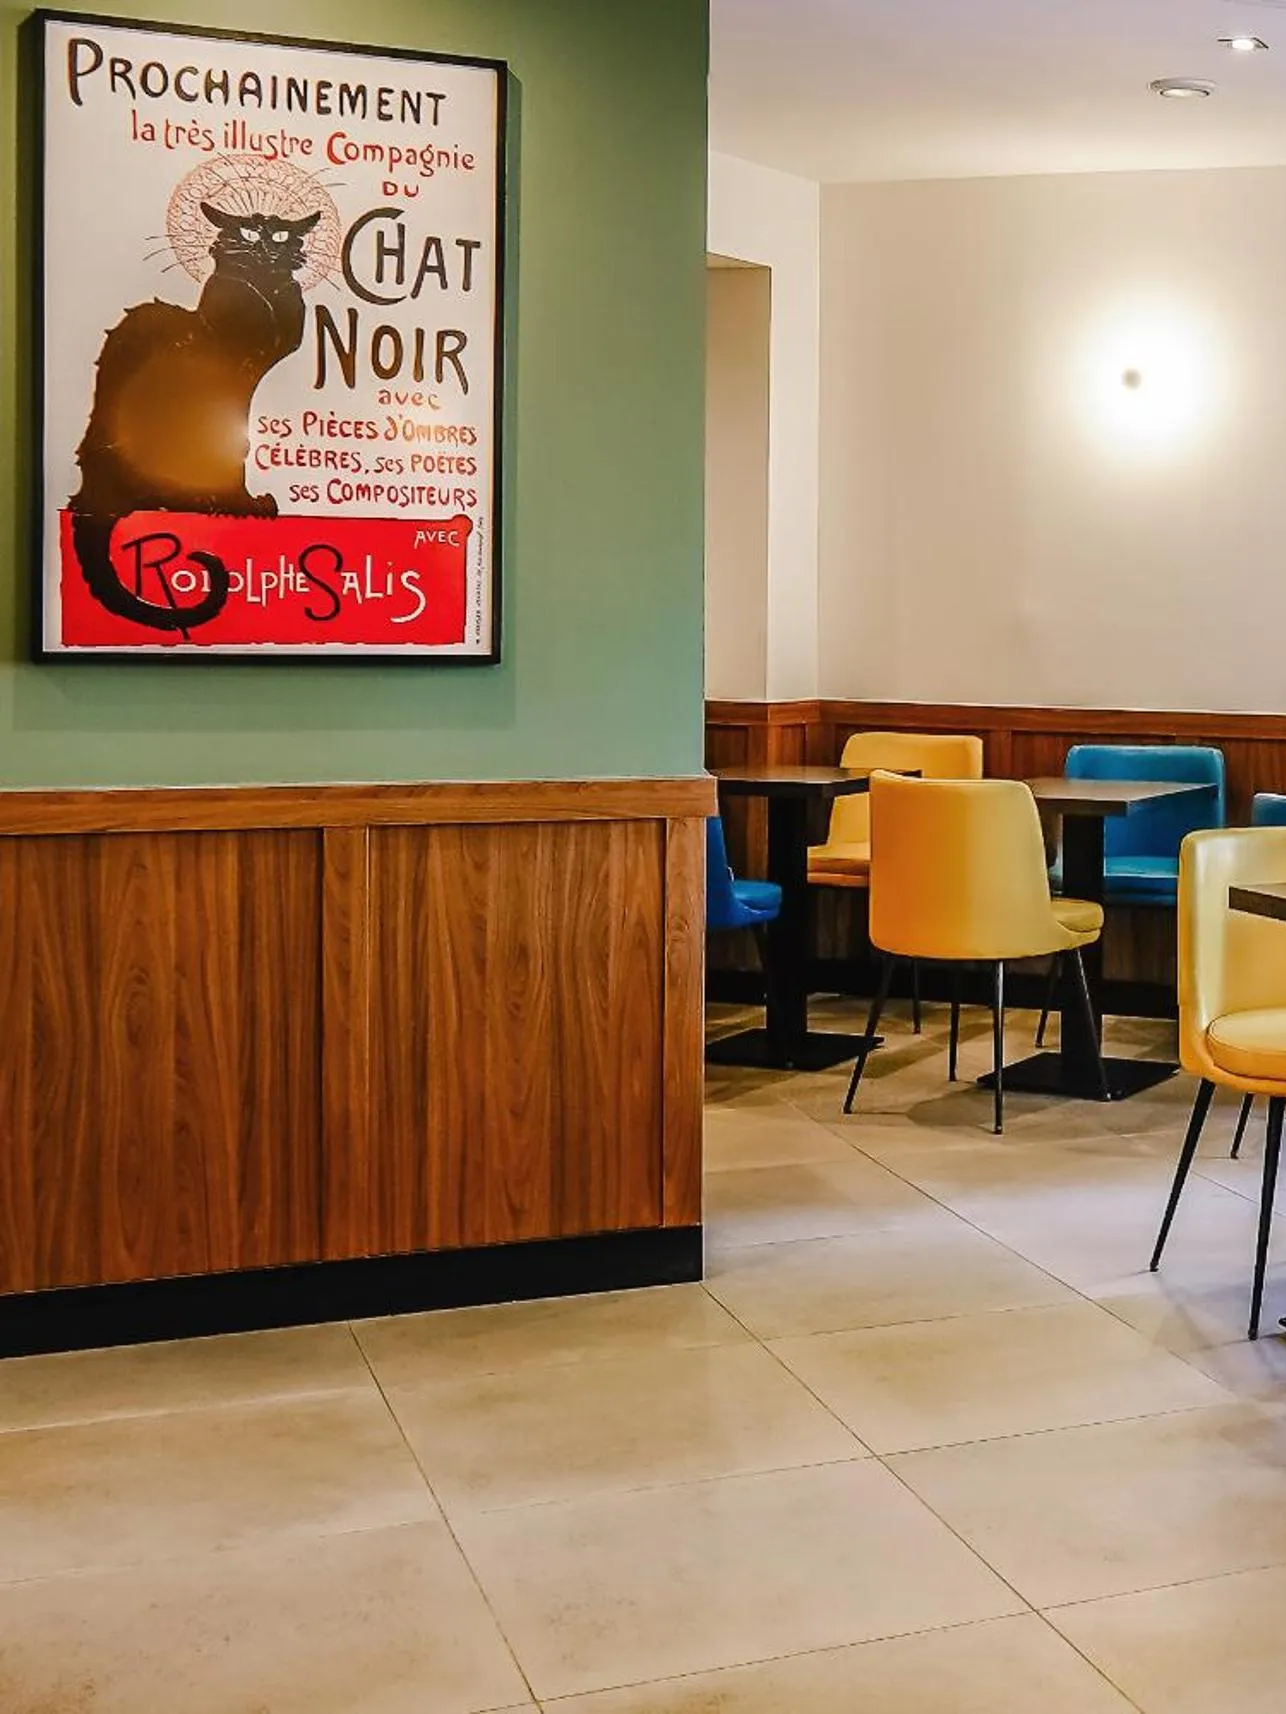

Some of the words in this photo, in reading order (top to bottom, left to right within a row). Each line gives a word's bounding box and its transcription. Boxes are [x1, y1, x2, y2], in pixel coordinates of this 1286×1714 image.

[68, 38, 447, 126] PROCHAINEMENT
[131, 109, 155, 142] la
[164, 114, 216, 152] très
[224, 120, 313, 160] illustre
[327, 131, 476, 177] Compagnie
[383, 181, 419, 198] DU
[341, 207, 481, 305] CHAT
[315, 304, 469, 395] NOIR
[378, 388, 441, 410] avec
[257, 414, 292, 438] ses
[303, 411, 379, 440] PIÈCES
[374, 456, 404, 474] ses
[289, 483, 320, 503] ses
[327, 478, 478, 511] COMPOSITEURS
[414, 529, 460, 548] AVEC
